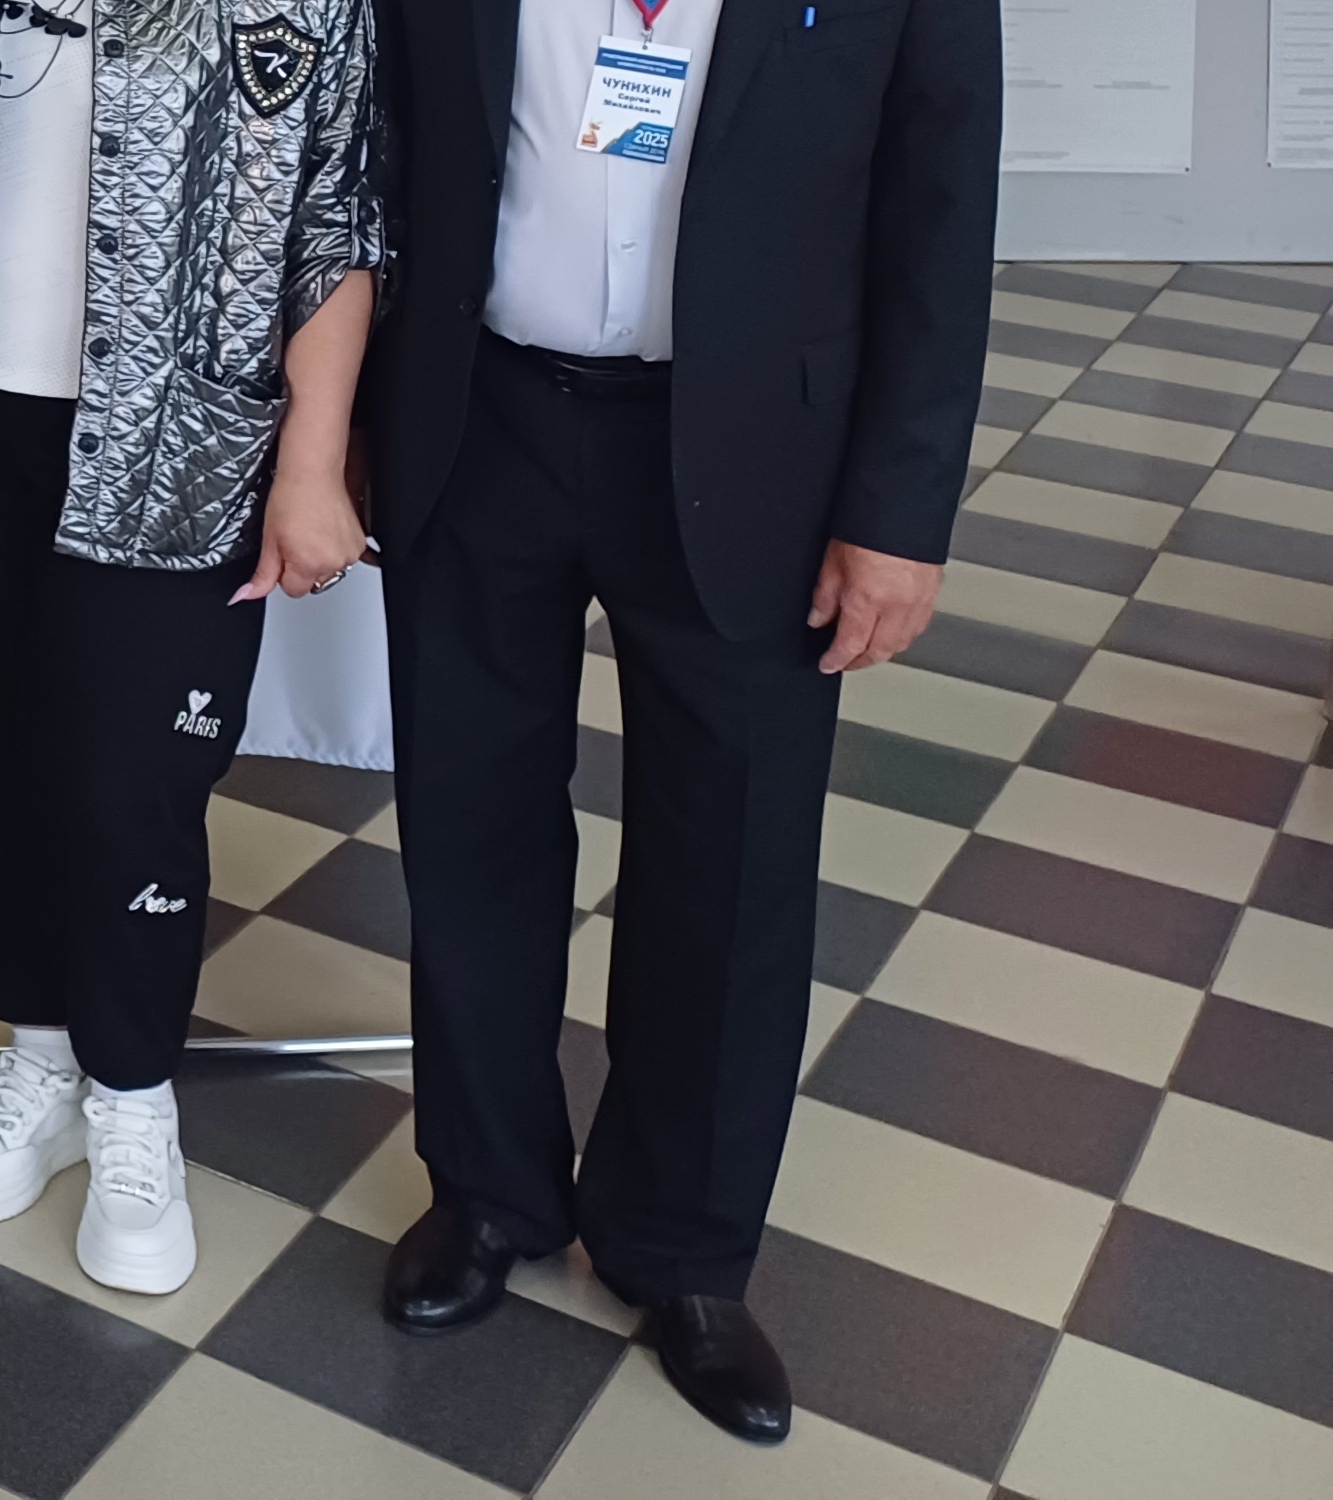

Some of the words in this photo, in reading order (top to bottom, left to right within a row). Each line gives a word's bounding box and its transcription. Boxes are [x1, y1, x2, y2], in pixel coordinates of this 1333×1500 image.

[602, 76, 672, 98] ЧУНИХИН
[633, 129, 669, 148] 2025
[173, 710, 222, 739] PARIS
